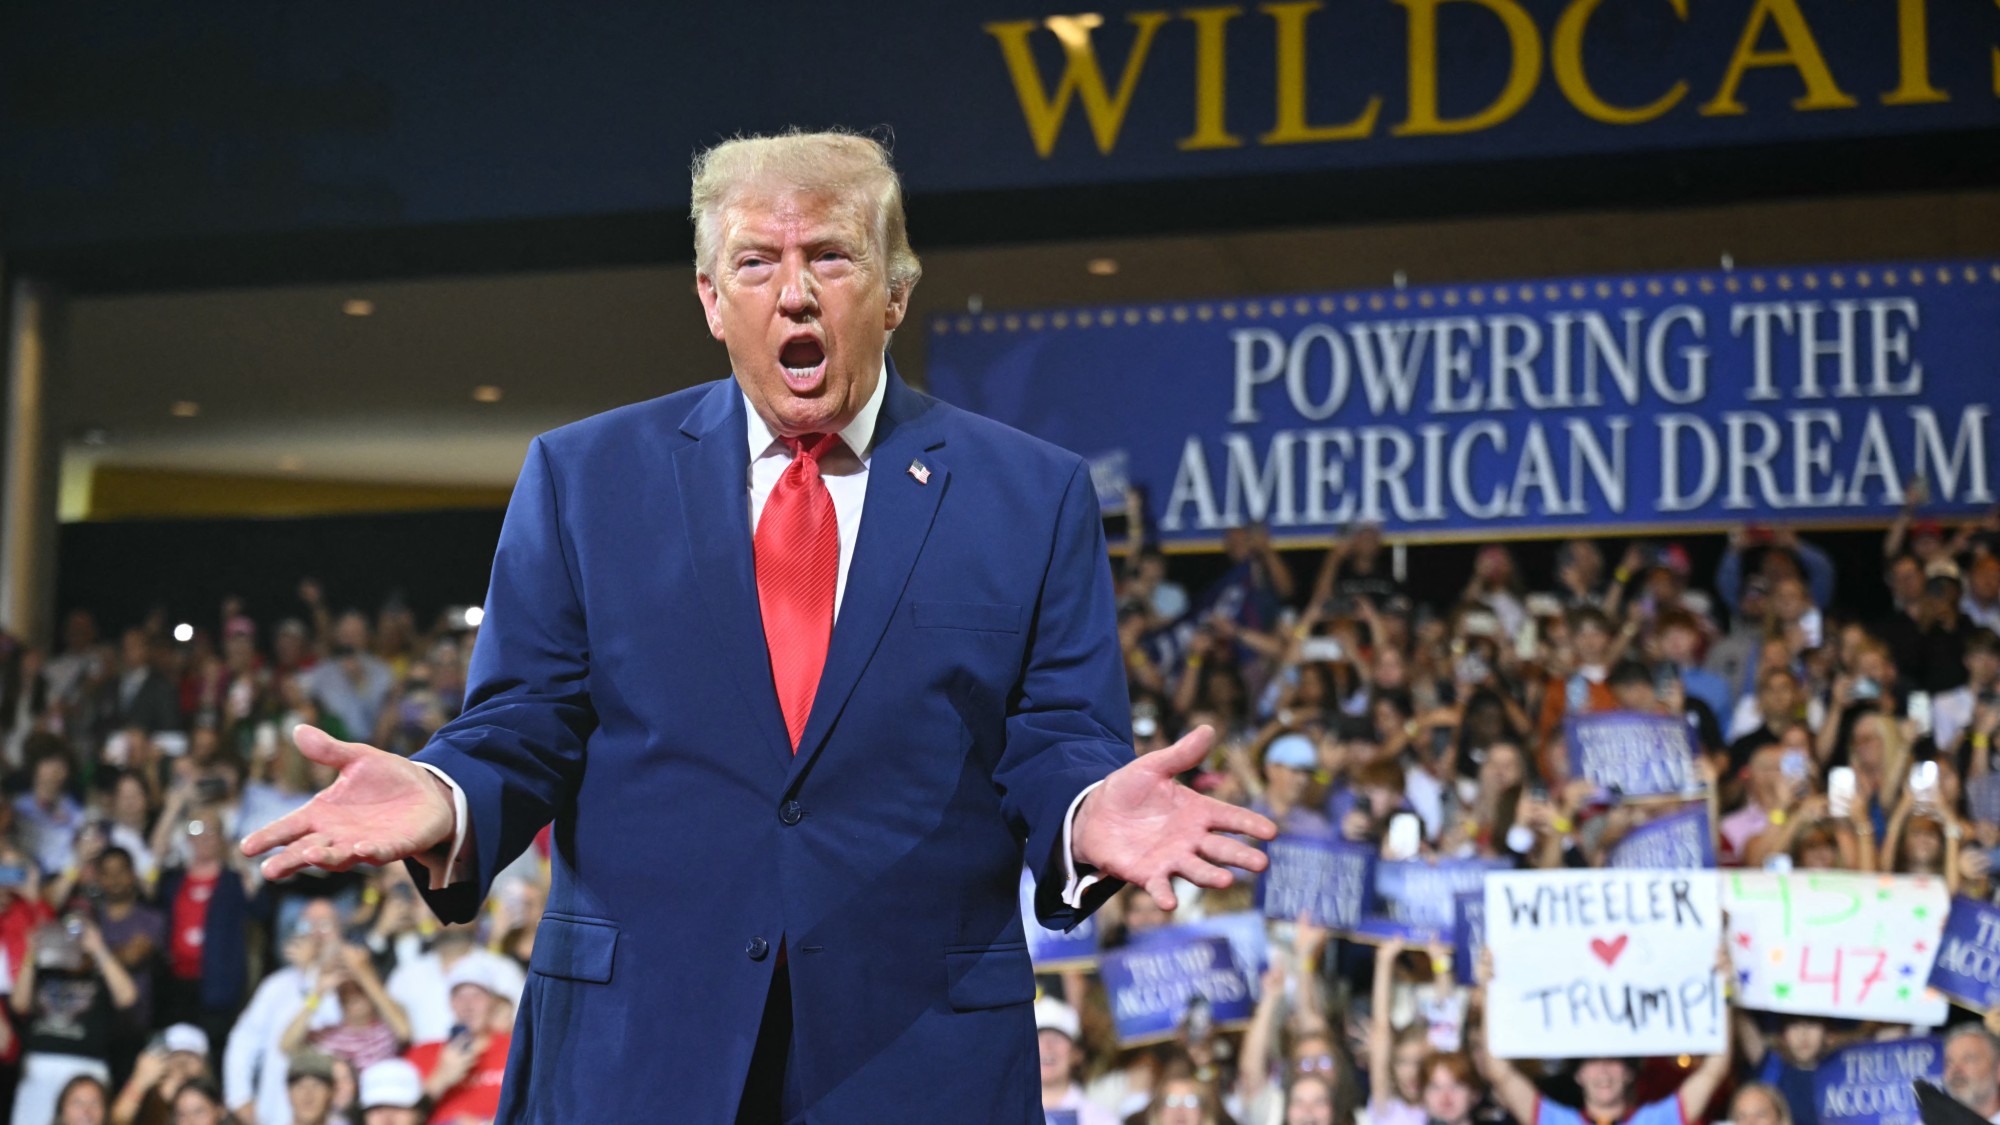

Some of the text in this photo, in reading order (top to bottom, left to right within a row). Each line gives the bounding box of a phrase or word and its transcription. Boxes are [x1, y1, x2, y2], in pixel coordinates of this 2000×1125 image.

[984, 0, 2000, 159] WILDCAT
[1229, 297, 1922, 423] POWERING THE
[1161, 403, 1990, 531] AMERICAN DREAM
[1503, 878, 1704, 927] WHEELER
[1731, 872, 1862, 938] 45
[1122, 941, 1217, 988] TRUMP
[1800, 946, 1887, 1005] 47
[1521, 966, 1717, 1036] TRUMP!
[1842, 1042, 1935, 1085] TRUMP
